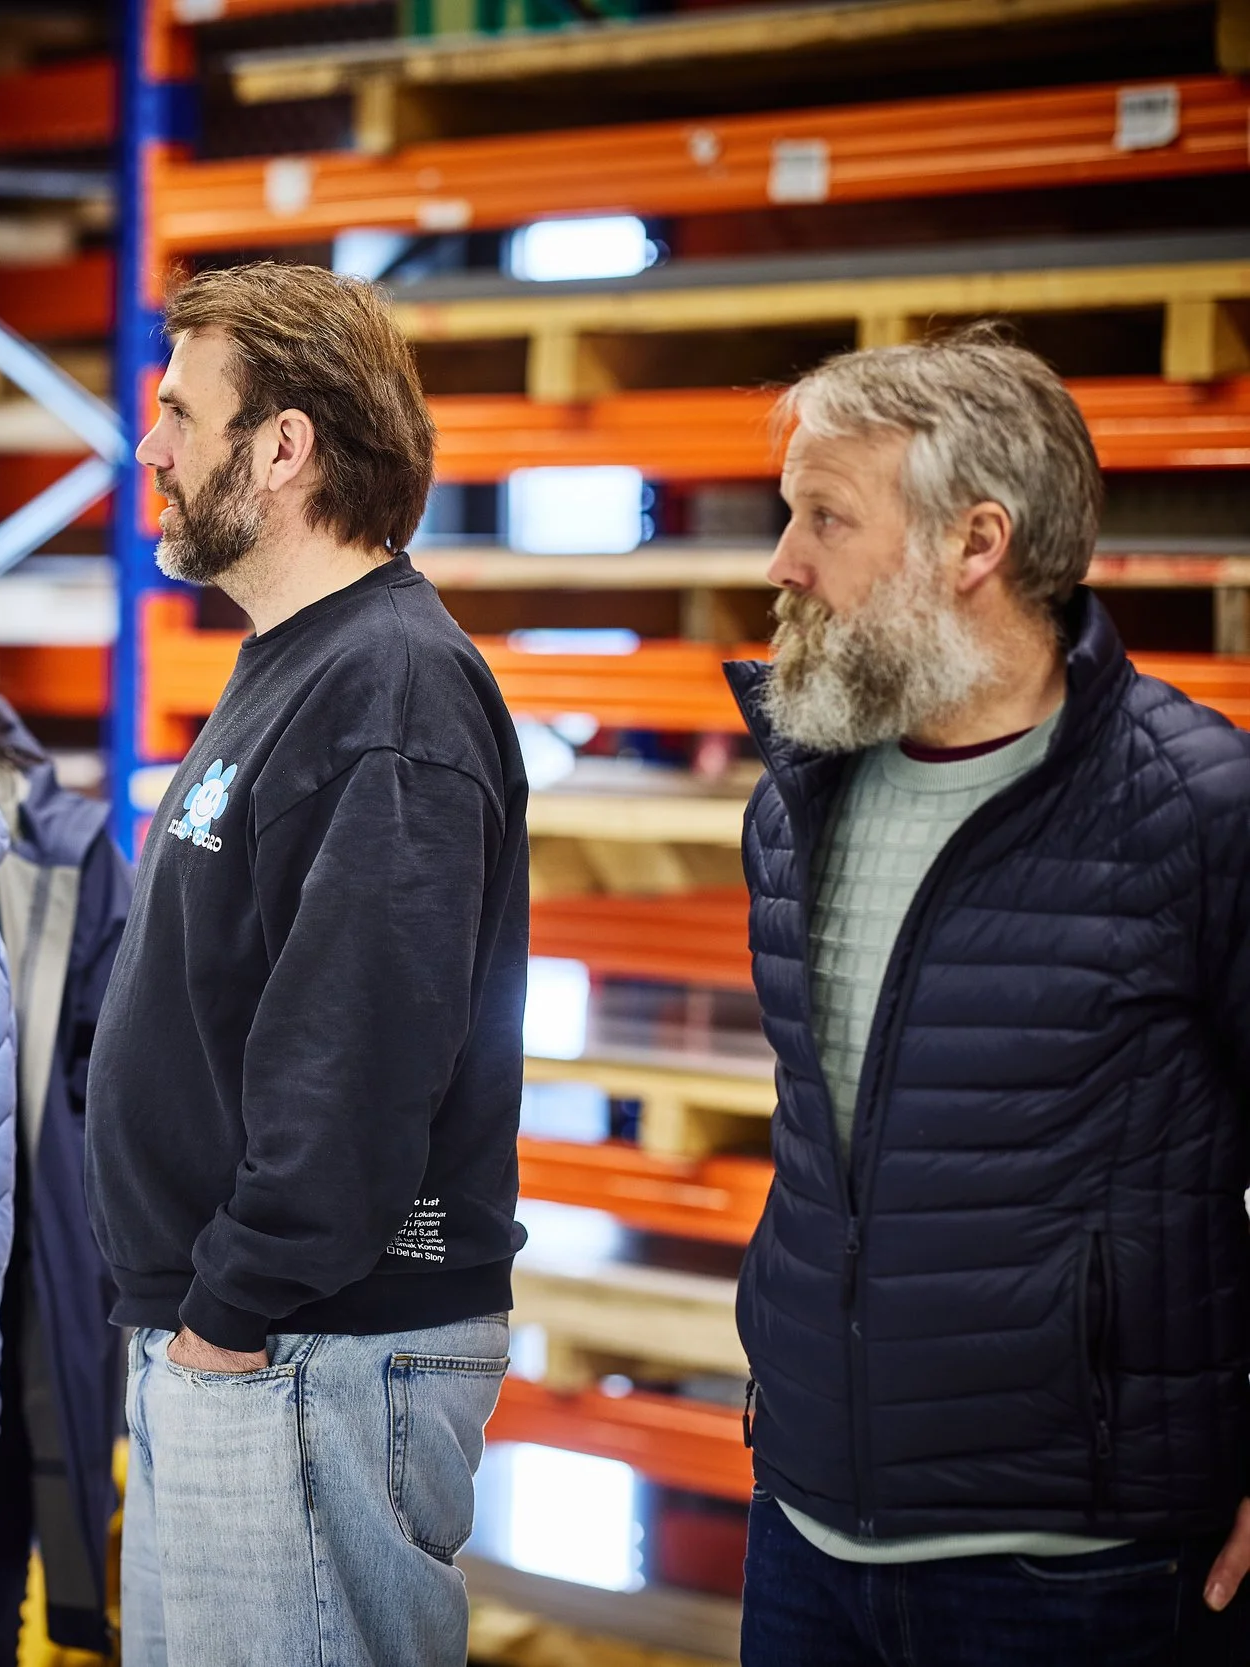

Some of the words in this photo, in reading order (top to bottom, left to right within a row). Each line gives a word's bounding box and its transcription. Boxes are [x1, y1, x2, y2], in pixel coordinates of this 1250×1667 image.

[422, 1198, 440, 1206] List
[413, 1219, 441, 1228] Fjorden
[396, 1248, 410, 1257] Del
[410, 1250, 424, 1259] din
[424, 1252, 445, 1264] Story
